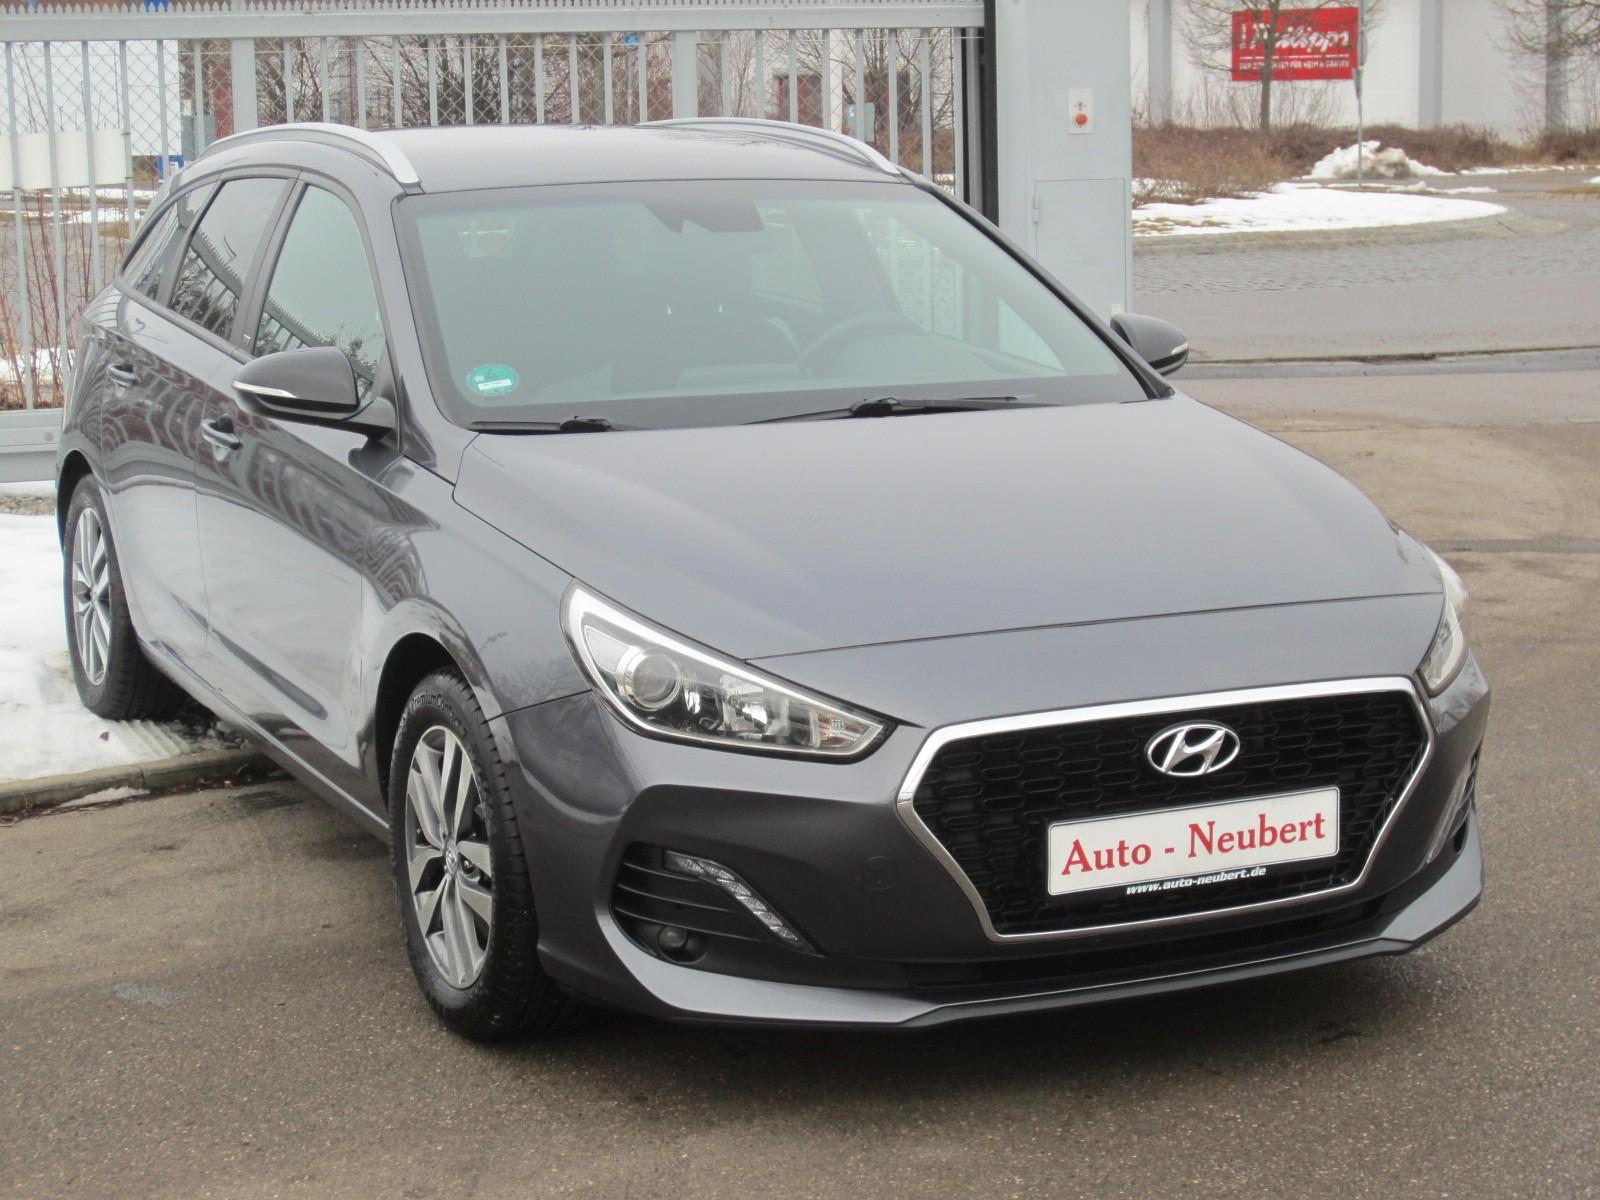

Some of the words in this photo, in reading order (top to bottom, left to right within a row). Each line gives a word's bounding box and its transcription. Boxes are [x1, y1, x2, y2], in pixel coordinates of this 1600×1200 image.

[1061, 838, 1152, 876] Auto
[1187, 812, 1326, 858] Neubert
[1126, 865, 1267, 895] www.auto-neubert.de
